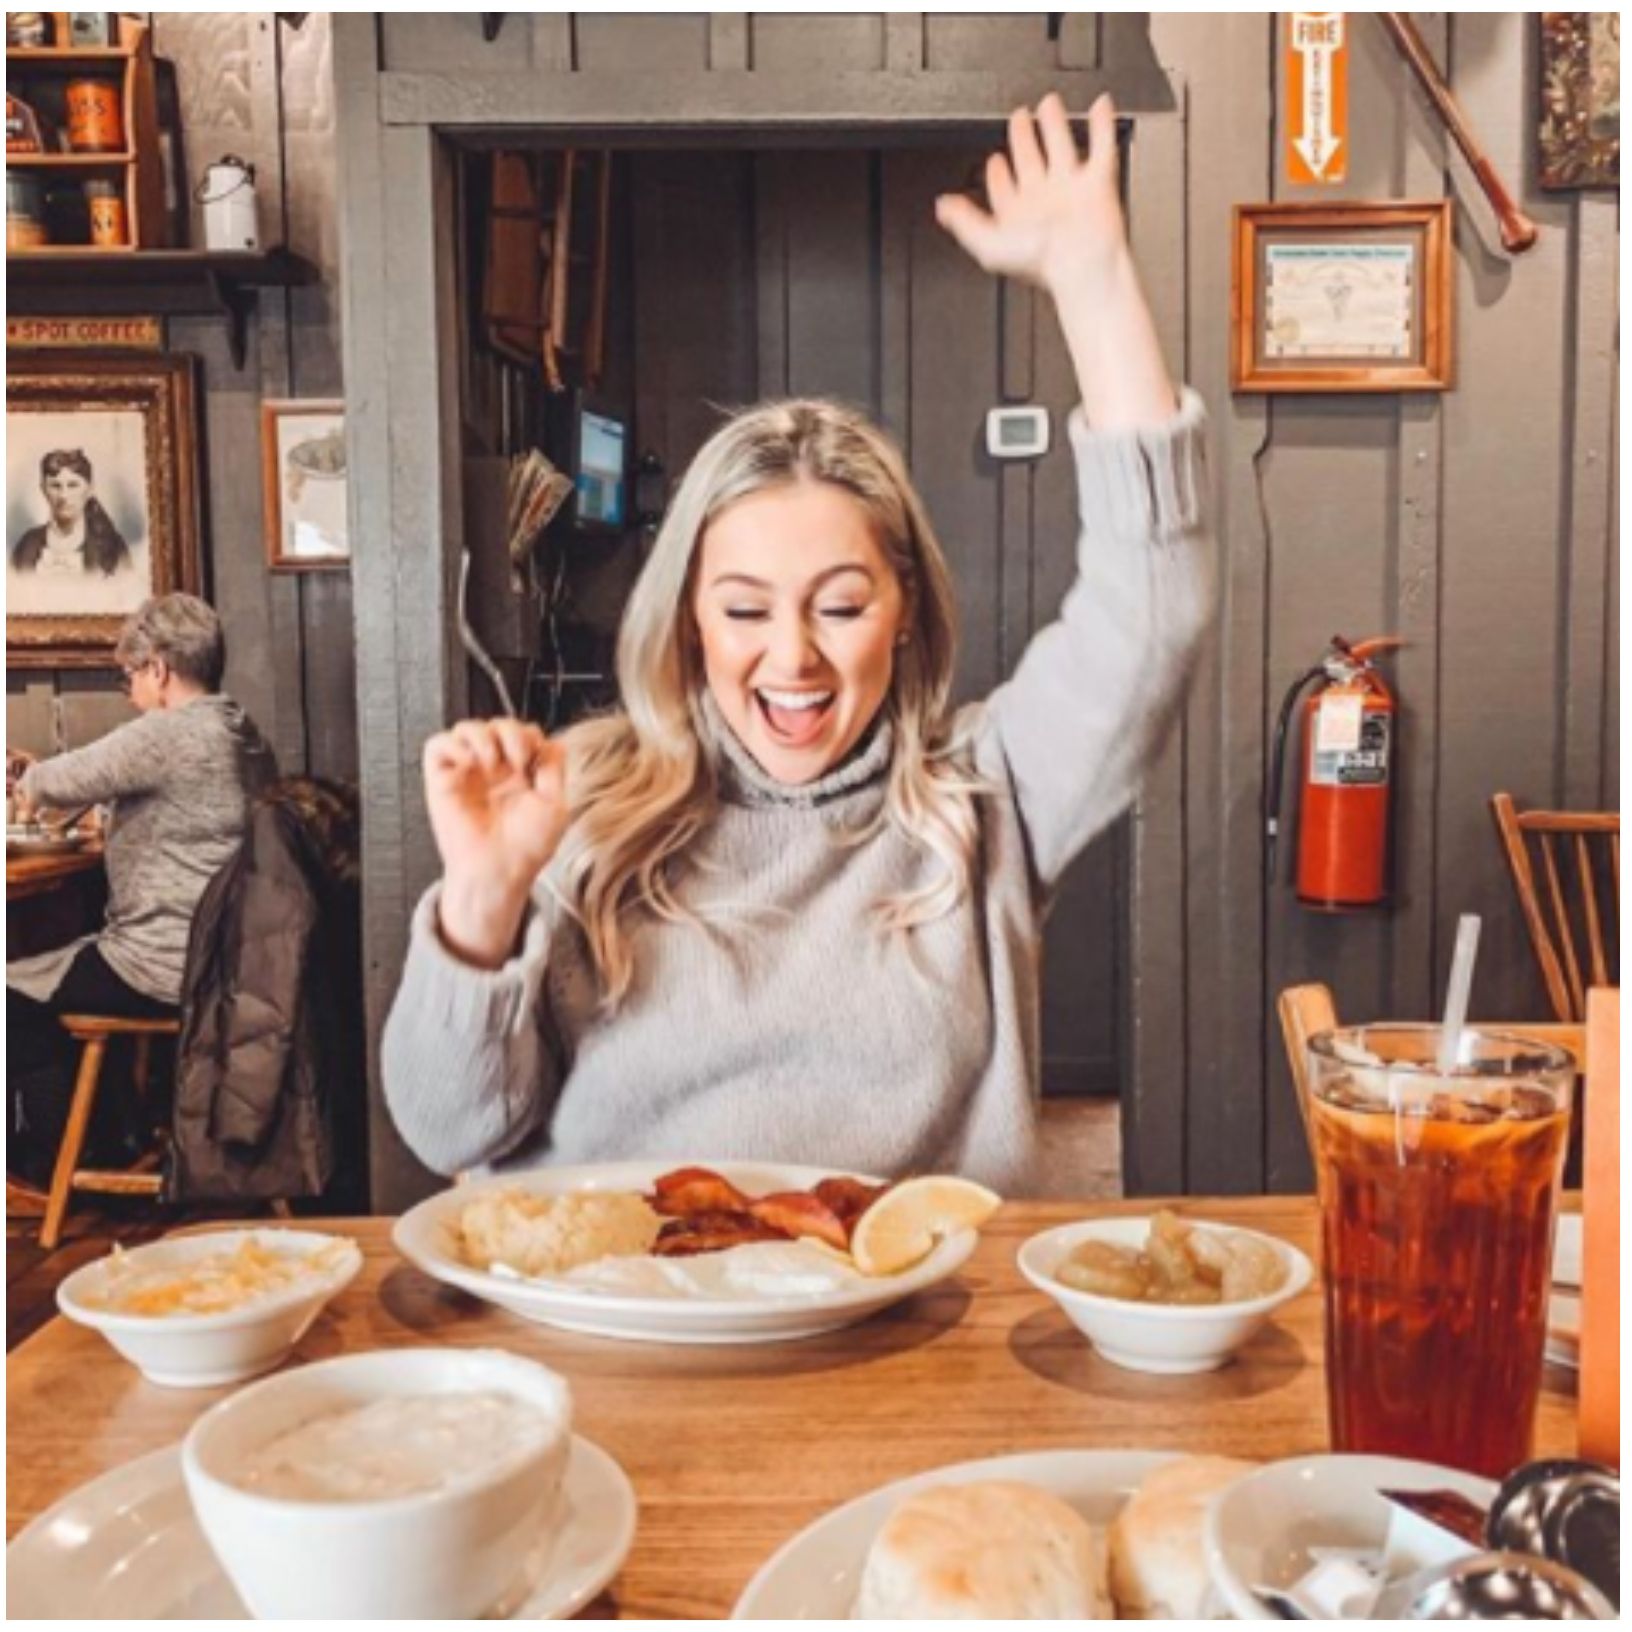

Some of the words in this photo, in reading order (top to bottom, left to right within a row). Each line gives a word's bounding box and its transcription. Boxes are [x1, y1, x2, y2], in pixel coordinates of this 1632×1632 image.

[1297, 20, 1337, 44] FIRE
[23, 321, 69, 342] SPOT
[77, 322, 145, 342] COFFEE
